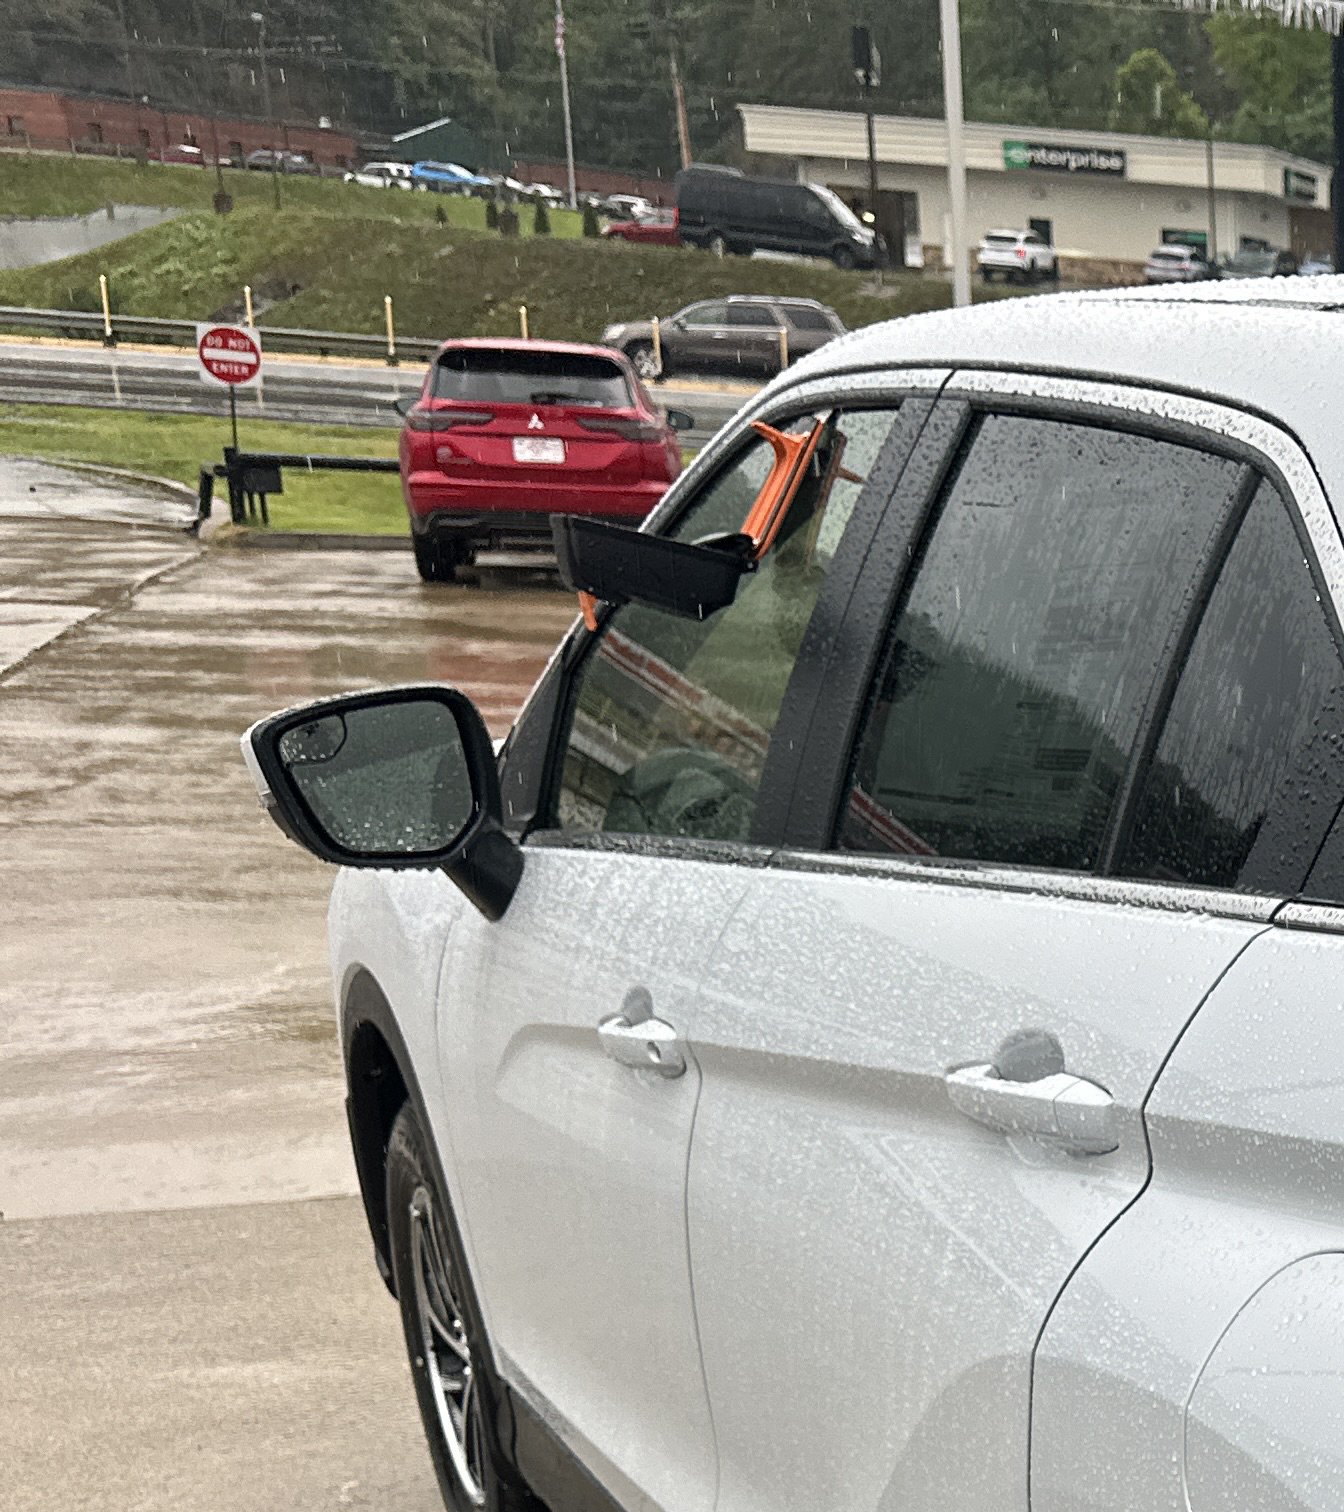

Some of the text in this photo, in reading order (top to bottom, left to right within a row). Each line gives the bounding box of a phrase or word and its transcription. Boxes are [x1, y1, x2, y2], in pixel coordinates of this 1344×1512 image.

[1008, 148, 1121, 171] enterprise
[206, 335, 250, 351] DO NOT
[212, 361, 249, 376] ENTER
